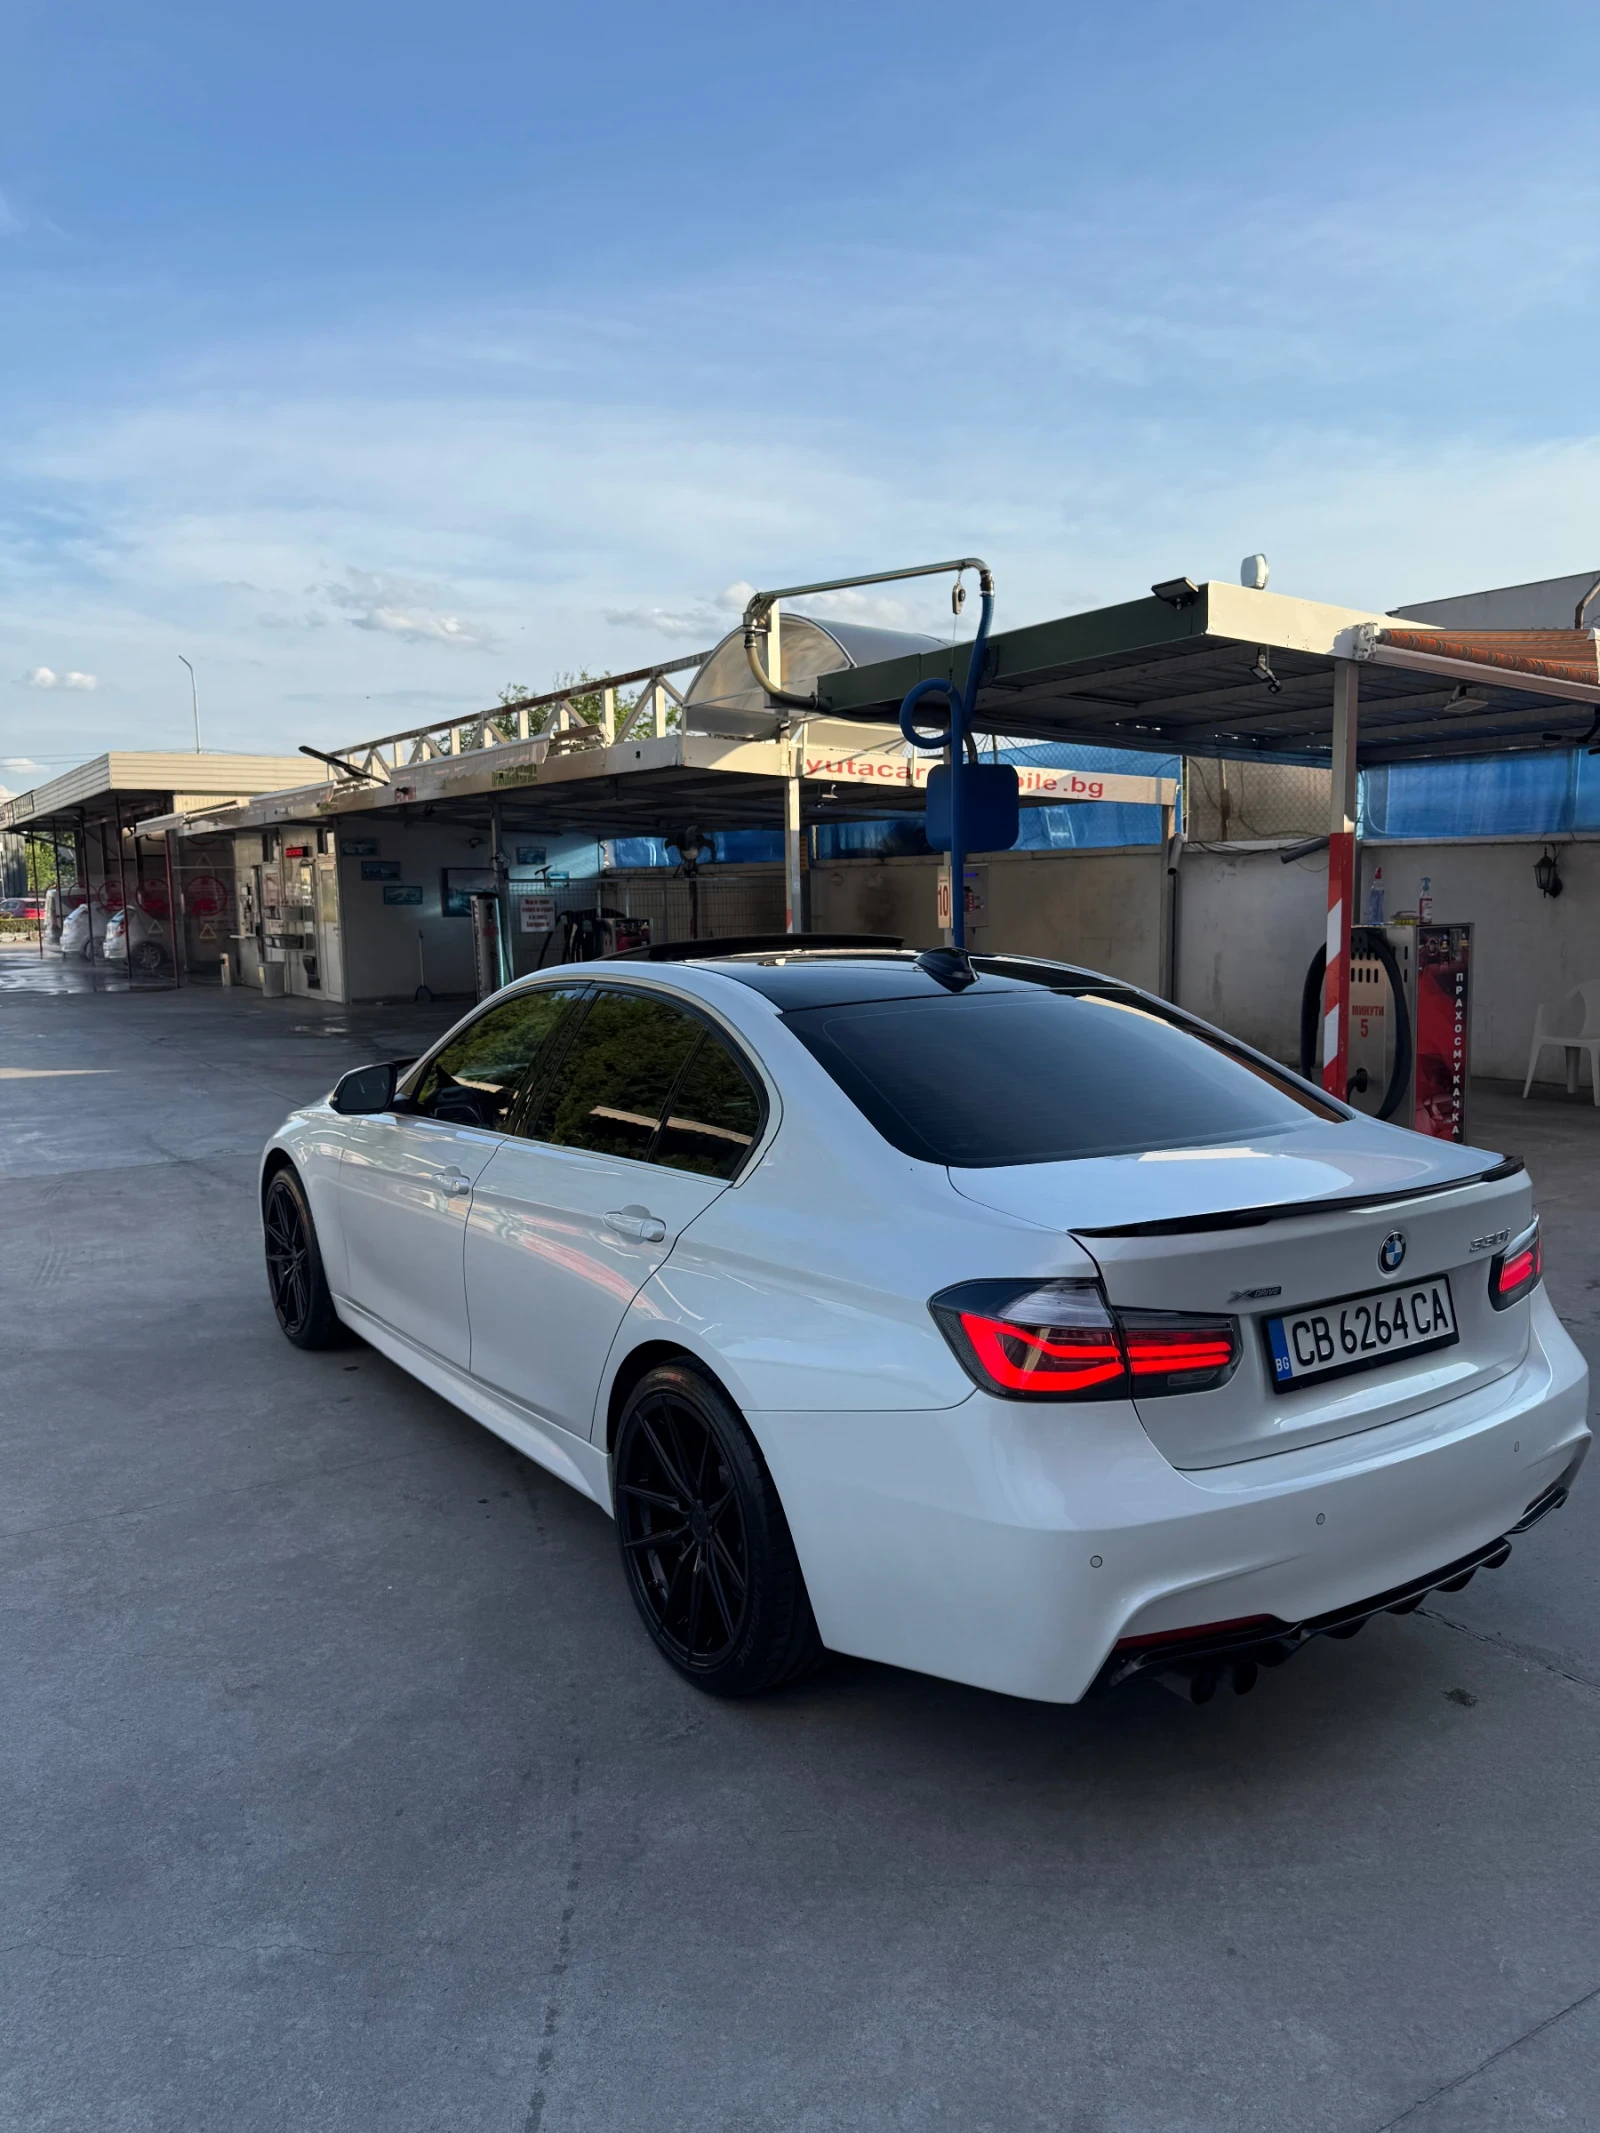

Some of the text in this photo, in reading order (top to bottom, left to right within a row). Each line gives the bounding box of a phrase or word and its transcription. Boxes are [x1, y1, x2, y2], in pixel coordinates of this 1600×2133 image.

[938, 885, 949, 917] 10
[1352, 1005, 1385, 1017] МИНУТИ
[1360, 1018, 1369, 1038] 5
[1452, 972, 1464, 1134] ПРАХОСМУКАЧКА
[1469, 1227, 1511, 1252] 330i
[1275, 1357, 1291, 1372] BG
